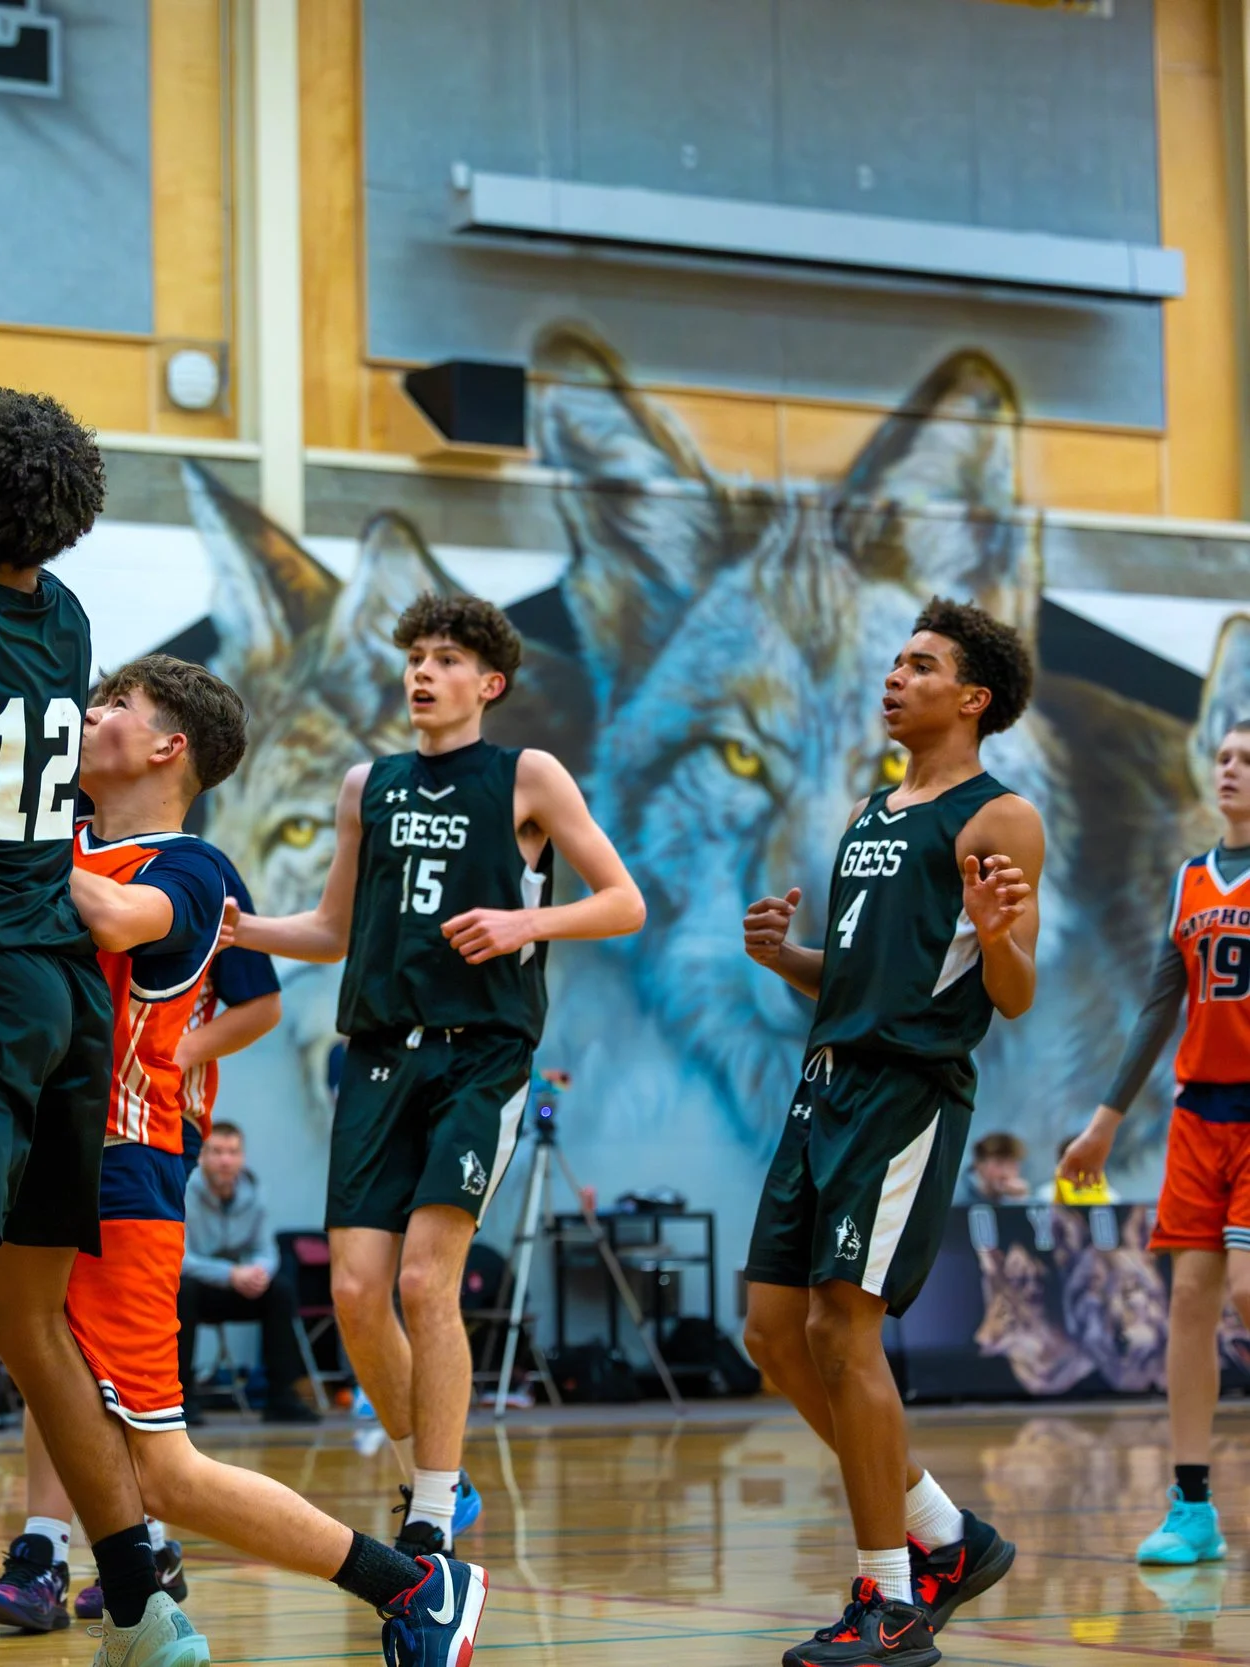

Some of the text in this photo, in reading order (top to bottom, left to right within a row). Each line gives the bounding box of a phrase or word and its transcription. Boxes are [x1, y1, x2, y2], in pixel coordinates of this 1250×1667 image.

[390, 811, 470, 850] GESS
[840, 839, 908, 878] GESS
[400, 855, 447, 915] 15
[836, 889, 868, 949] 4
[1193, 932, 1250, 1004] 19
